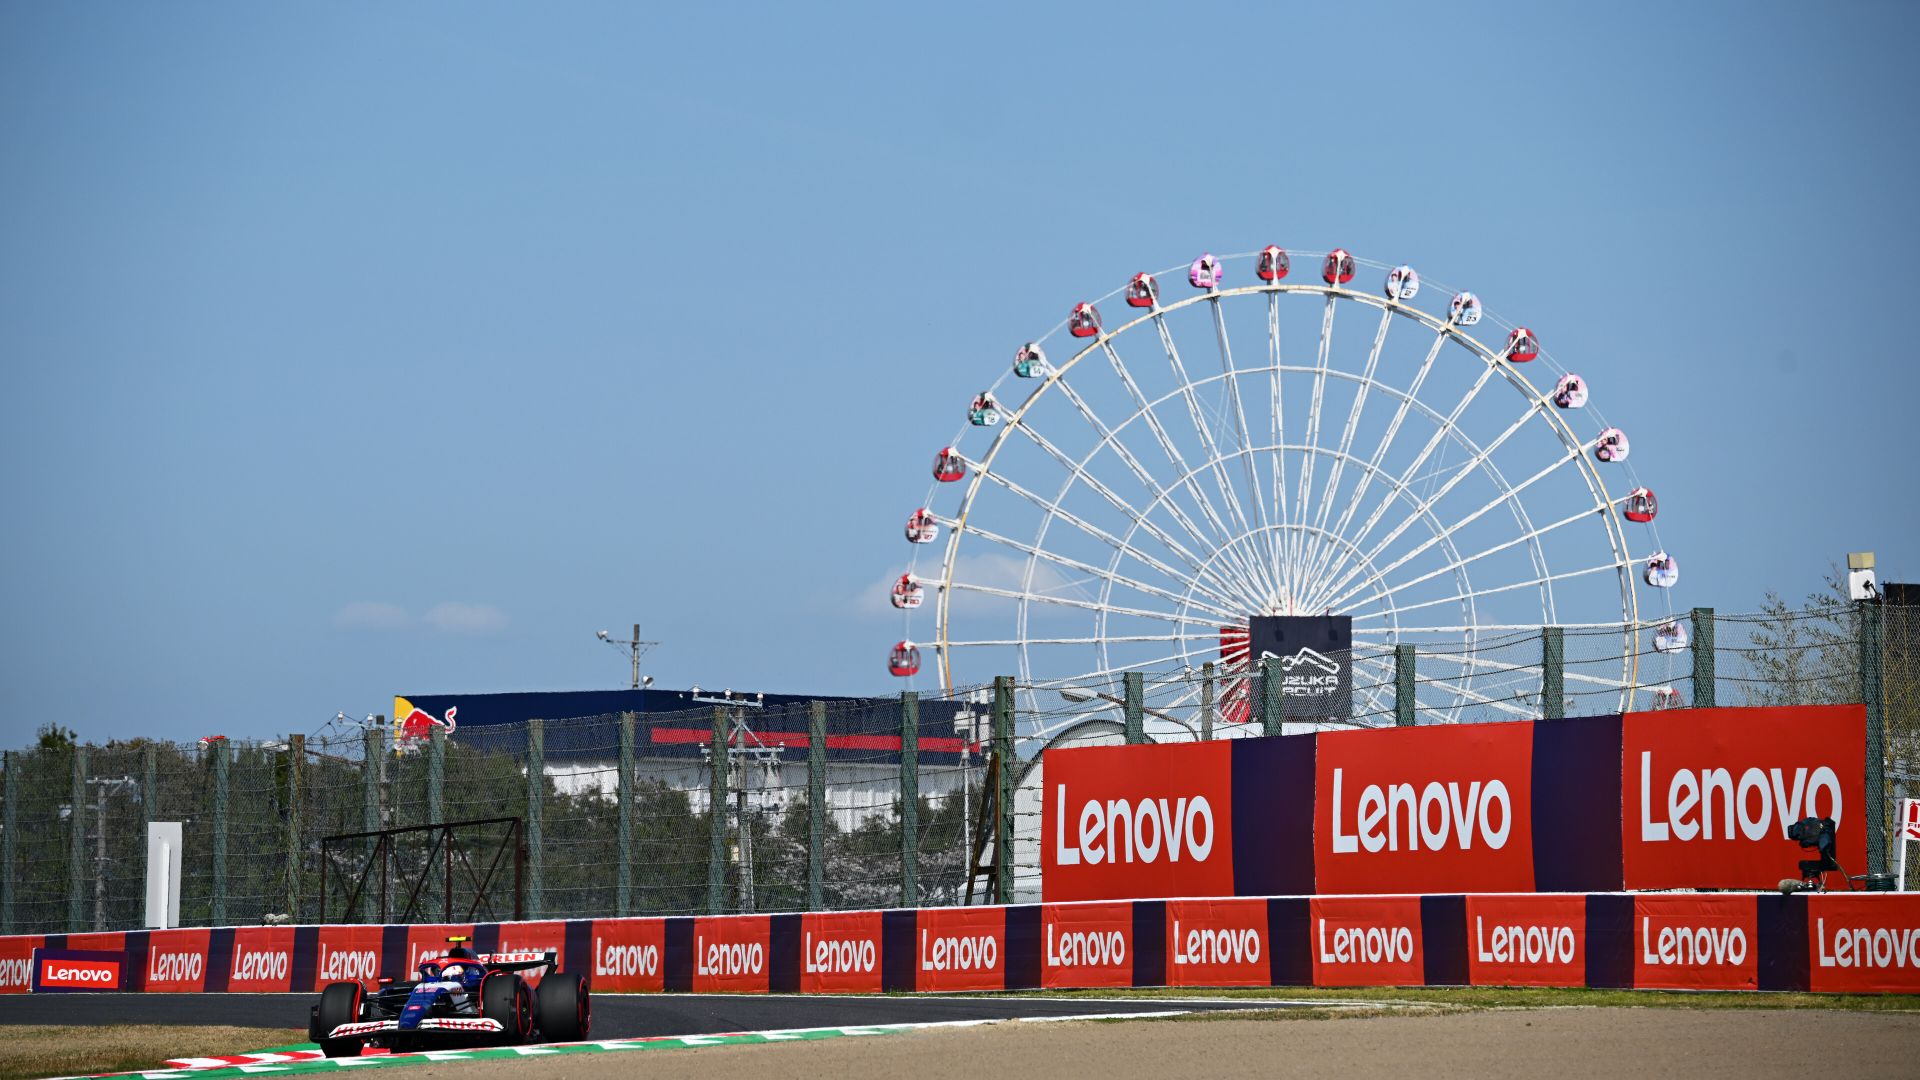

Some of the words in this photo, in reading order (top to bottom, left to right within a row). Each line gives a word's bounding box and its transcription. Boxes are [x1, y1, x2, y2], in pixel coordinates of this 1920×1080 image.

[1333, 768, 1511, 853] Lenovo
[1642, 751, 1842, 842] Lenovo
[1057, 784, 1213, 865] Lenovo
[596, 937, 658, 976] Lenovo
[698, 936, 763, 975] Lenovo
[806, 932, 875, 972] Lenovo
[922, 929, 997, 970] Lenovo
[1047, 925, 1125, 967] Lenovo
[1174, 921, 1260, 965] Lenovo
[1319, 918, 1413, 964] Lenovo
[1477, 917, 1574, 964] Lenovo
[1643, 917, 1746, 966] Lenovo
[47, 965, 112, 982] Lenovo
[150, 946, 202, 981] Lenovo
[232, 944, 288, 980] Lenovo
[320, 943, 376, 981] Lenovo
